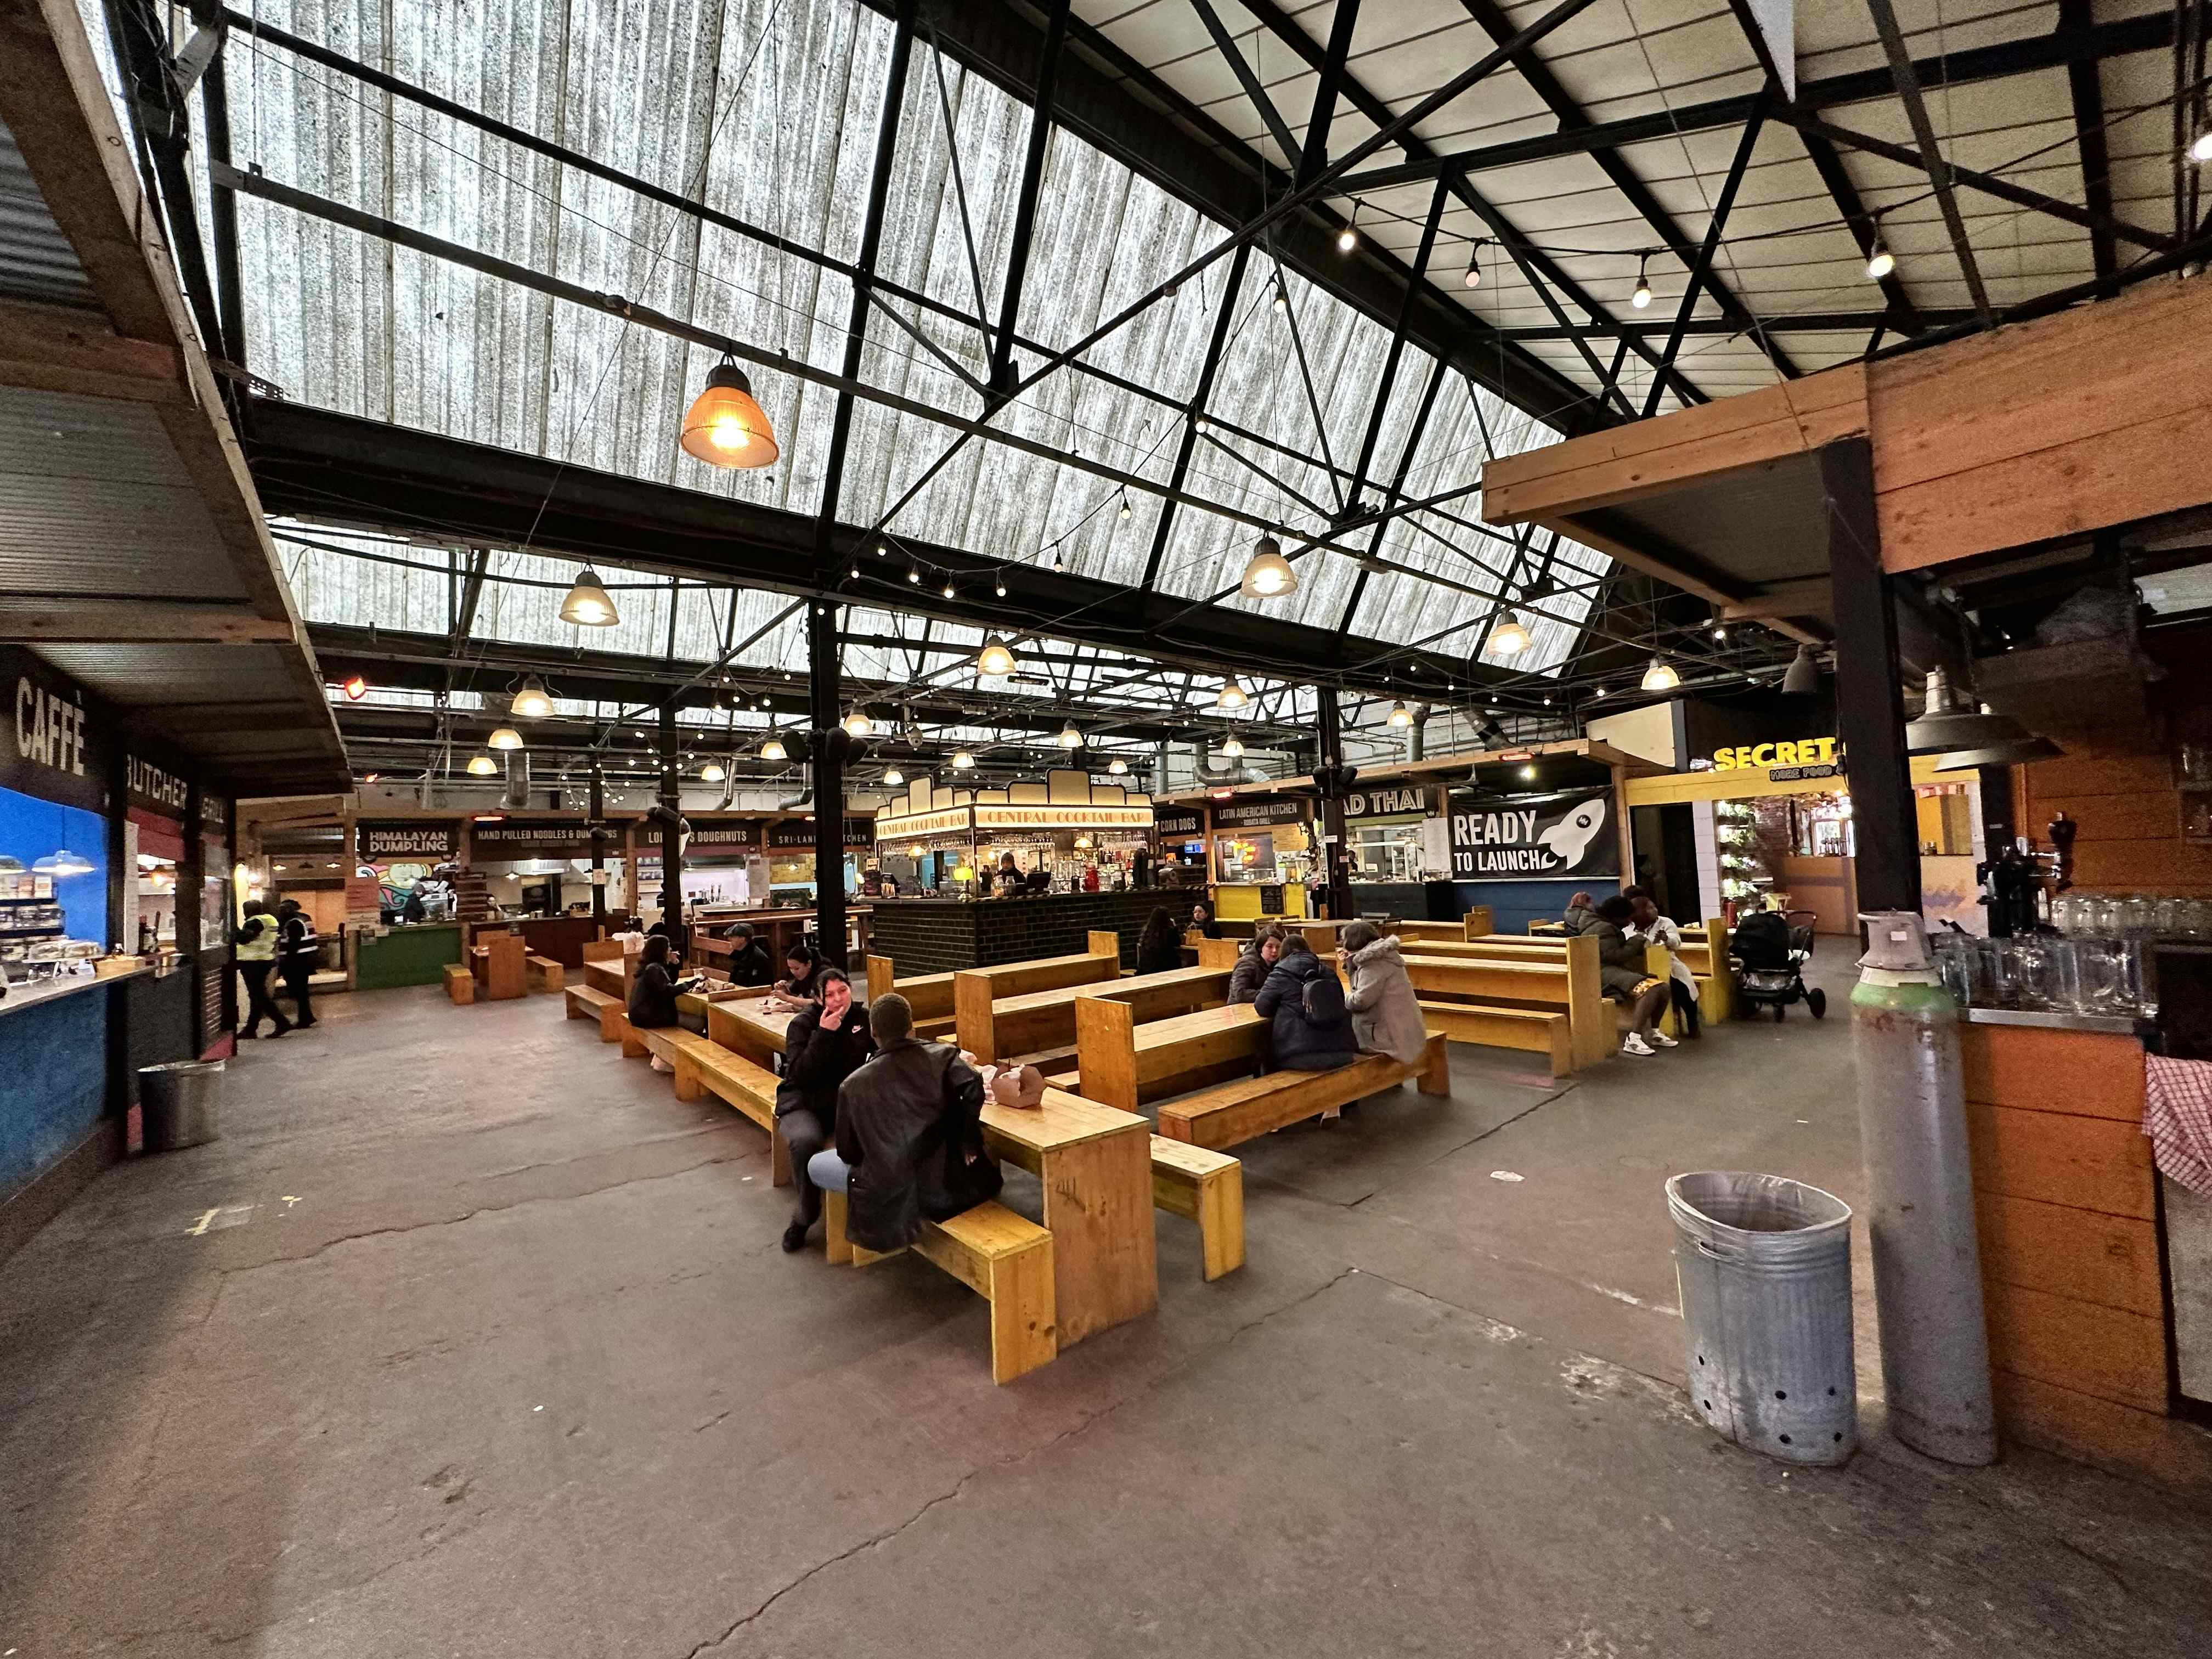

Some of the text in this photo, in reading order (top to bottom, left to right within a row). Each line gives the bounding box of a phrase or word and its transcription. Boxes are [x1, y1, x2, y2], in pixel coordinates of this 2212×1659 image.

[16, 676, 84, 776] CAFFÈ
[1714, 737, 1836, 771] SECRET
[1803, 766, 1832, 777] FOOD
[1370, 788, 1425, 813] THAI
[988, 811, 1144, 822] CENTRAL COCKTAIL BAR
[1220, 803, 1297, 820] LATIN AMERICAN KITCHEN
[879, 822, 909, 835] CENTRAL
[950, 814, 967, 826] BAR
[1160, 817, 1196, 832] CORN DOGS
[1454, 810, 1536, 845] READY
[370, 832, 448, 841] HIMALAYAN
[478, 830, 617, 840] HAND PULLED NOODLES & DUMGS
[697, 831, 747, 843] DOUGHNUTS
[778, 835, 816, 844] SRI-LAN
[370, 841, 448, 851] DUMPLING
[1454, 850, 1540, 871] TO LAUNCH
